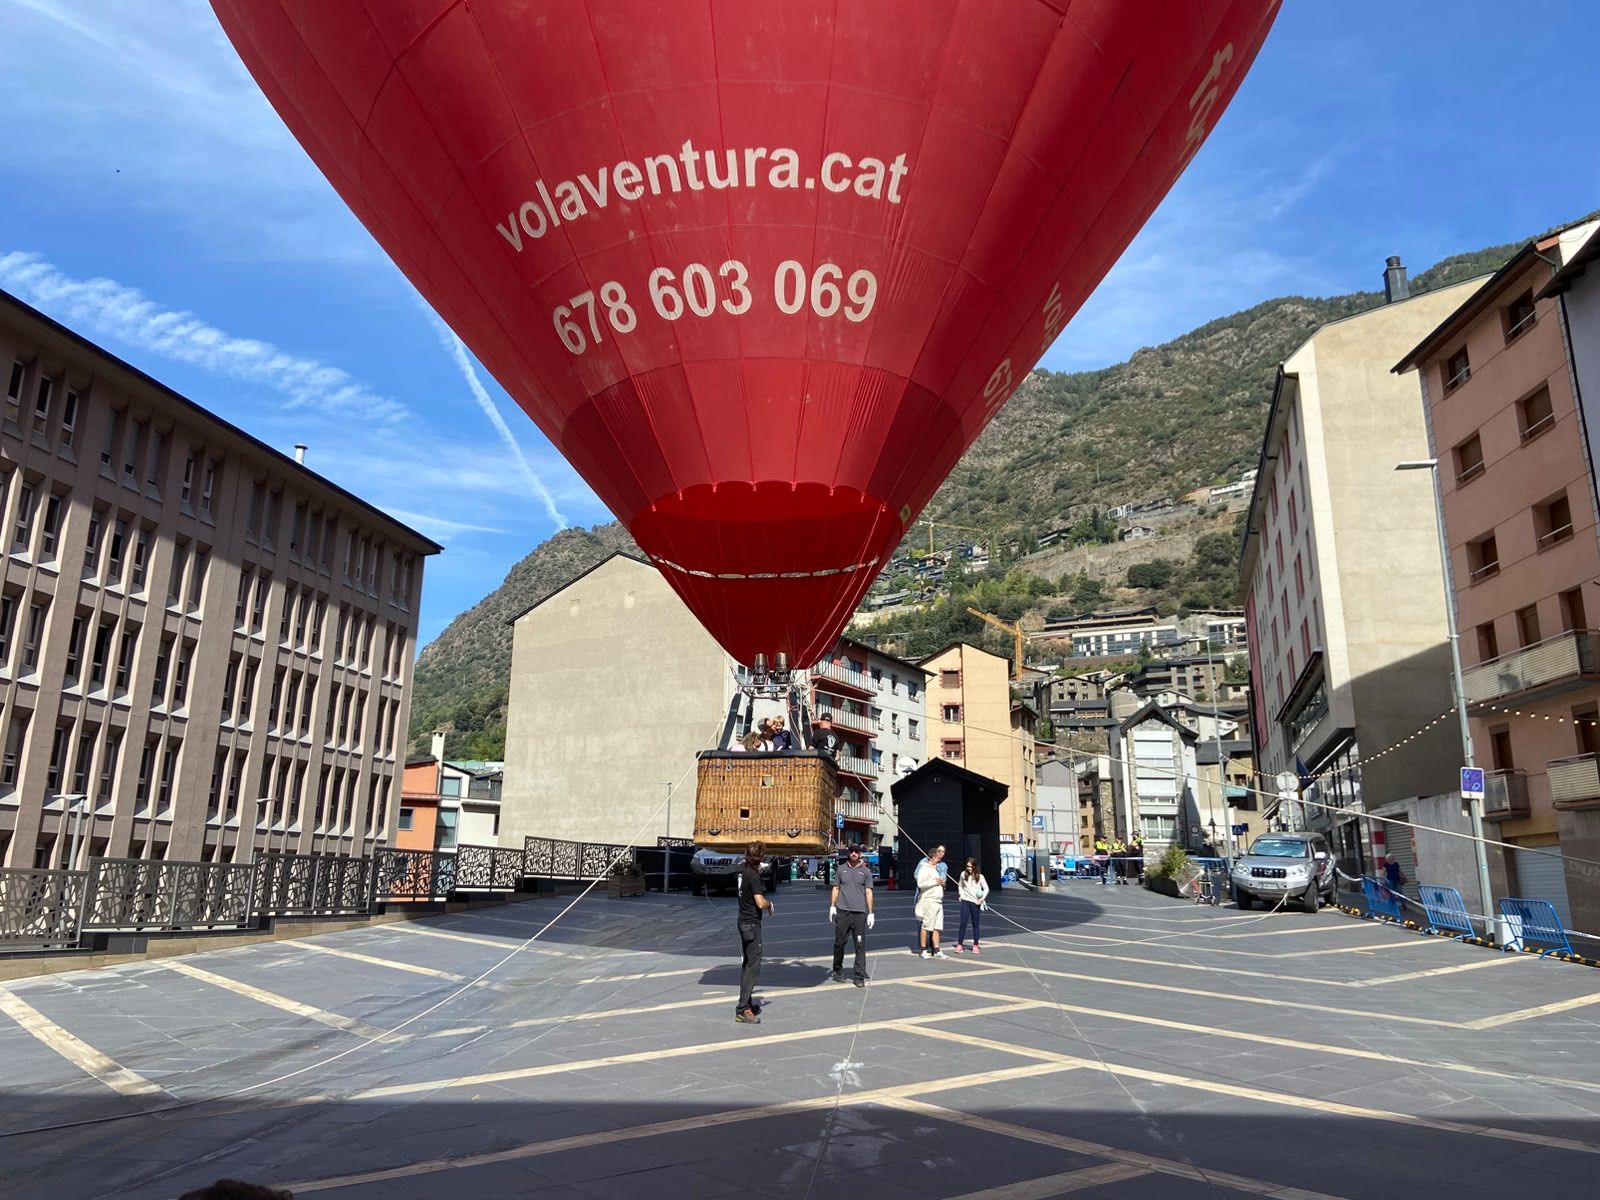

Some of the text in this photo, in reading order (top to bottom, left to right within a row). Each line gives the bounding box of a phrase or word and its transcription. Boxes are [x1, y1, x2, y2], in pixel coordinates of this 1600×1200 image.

[496, 139, 909, 252] volaventura.cat
[552, 260, 878, 355] 678 603 069
